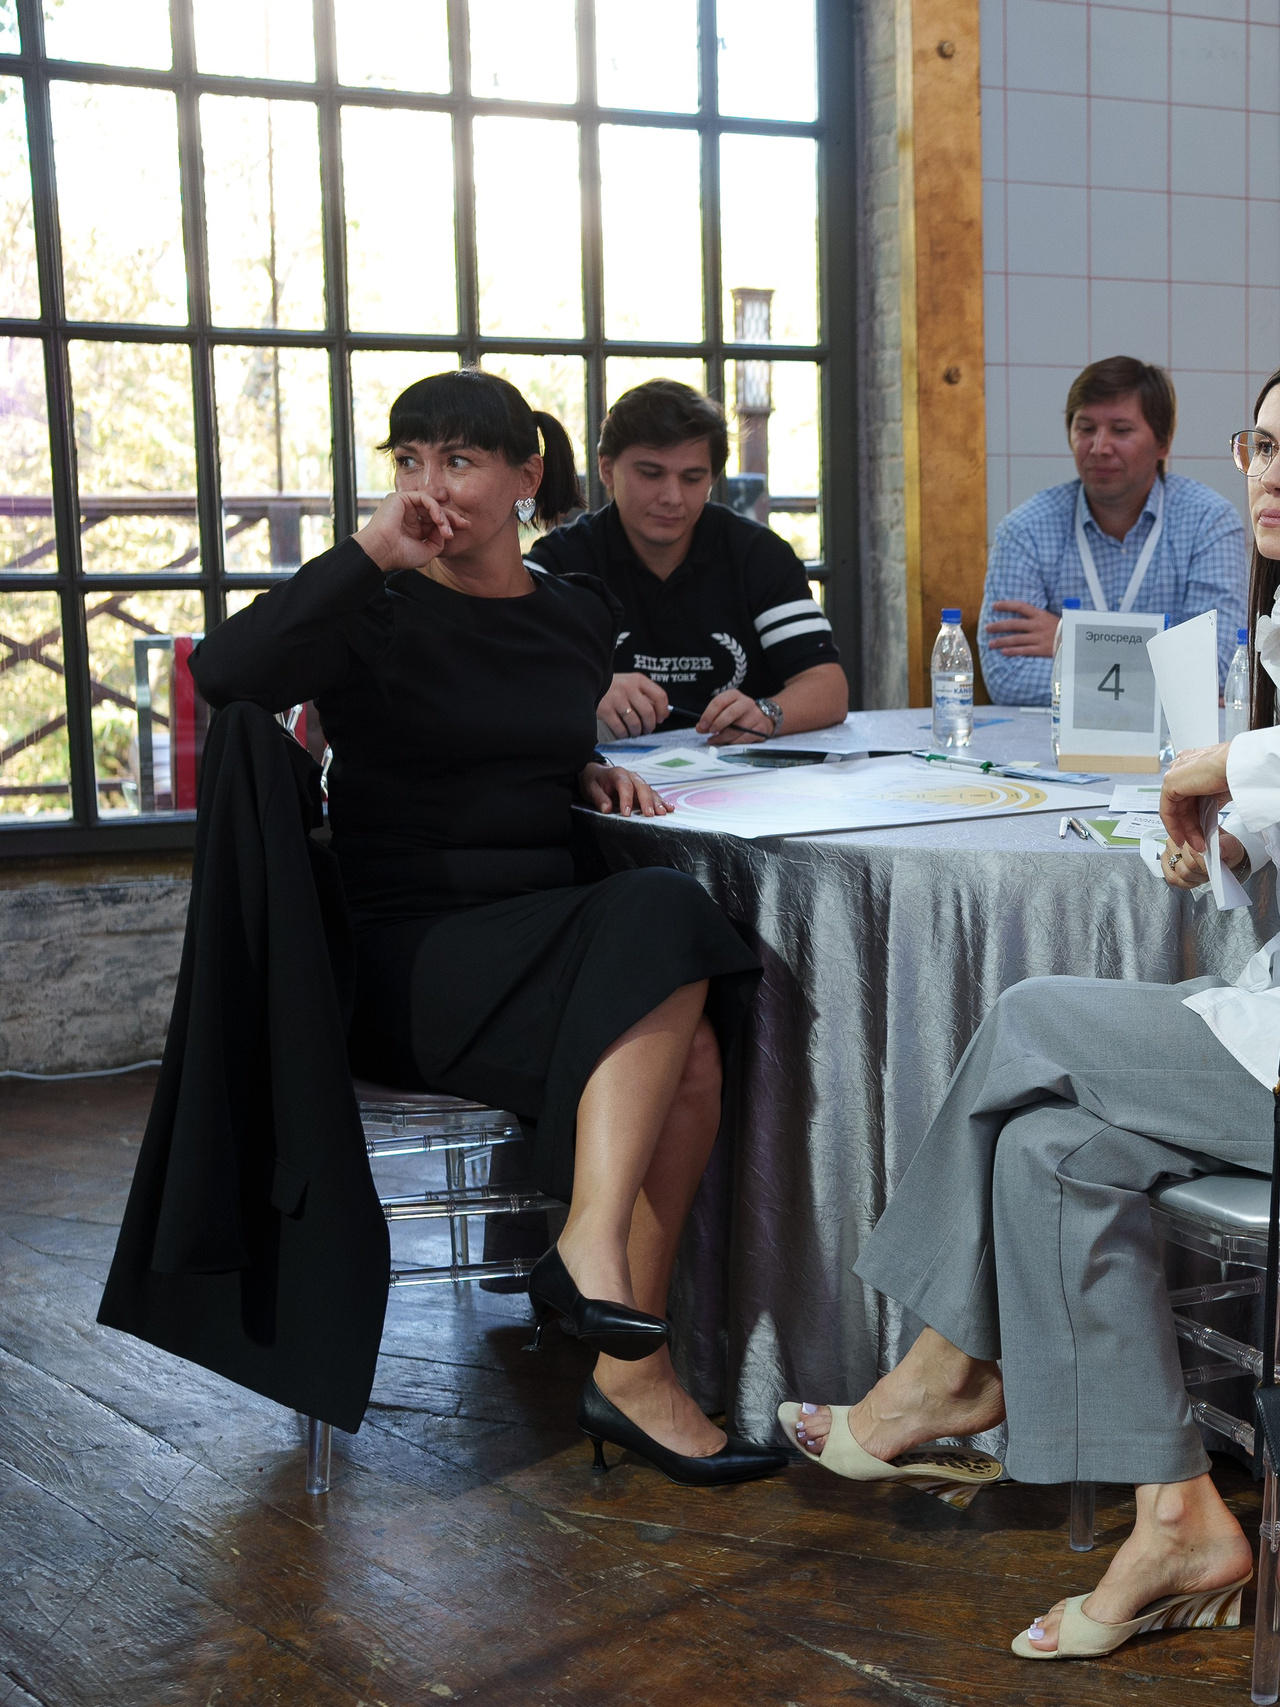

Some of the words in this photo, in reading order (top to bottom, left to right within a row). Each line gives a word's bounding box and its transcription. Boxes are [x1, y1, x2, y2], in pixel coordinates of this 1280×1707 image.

[1085, 631, 1143, 644] Эргосреда
[633, 653, 714, 671] HILFIGER
[650, 672, 669, 682] NEW
[671, 672, 697, 682] YORK
[1097, 663, 1125, 700] 4
